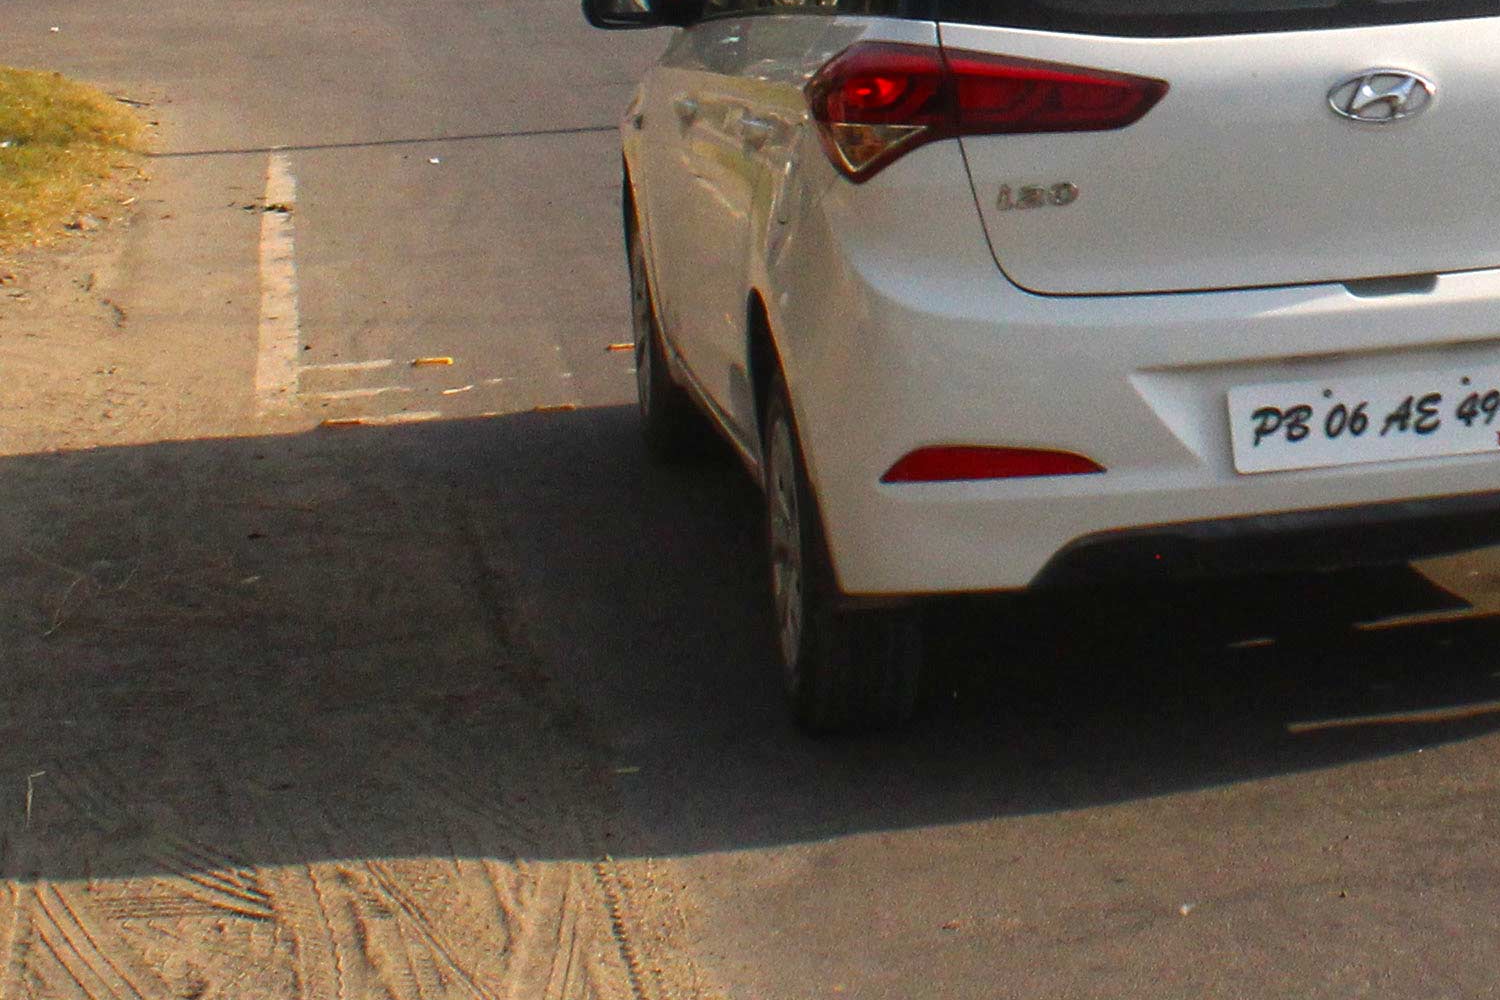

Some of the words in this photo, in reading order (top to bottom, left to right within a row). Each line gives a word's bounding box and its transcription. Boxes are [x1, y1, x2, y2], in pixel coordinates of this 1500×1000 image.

[1252, 404, 1313, 447] PB
[1324, 401, 1369, 440] 06
[1379, 391, 1443, 436] AE
